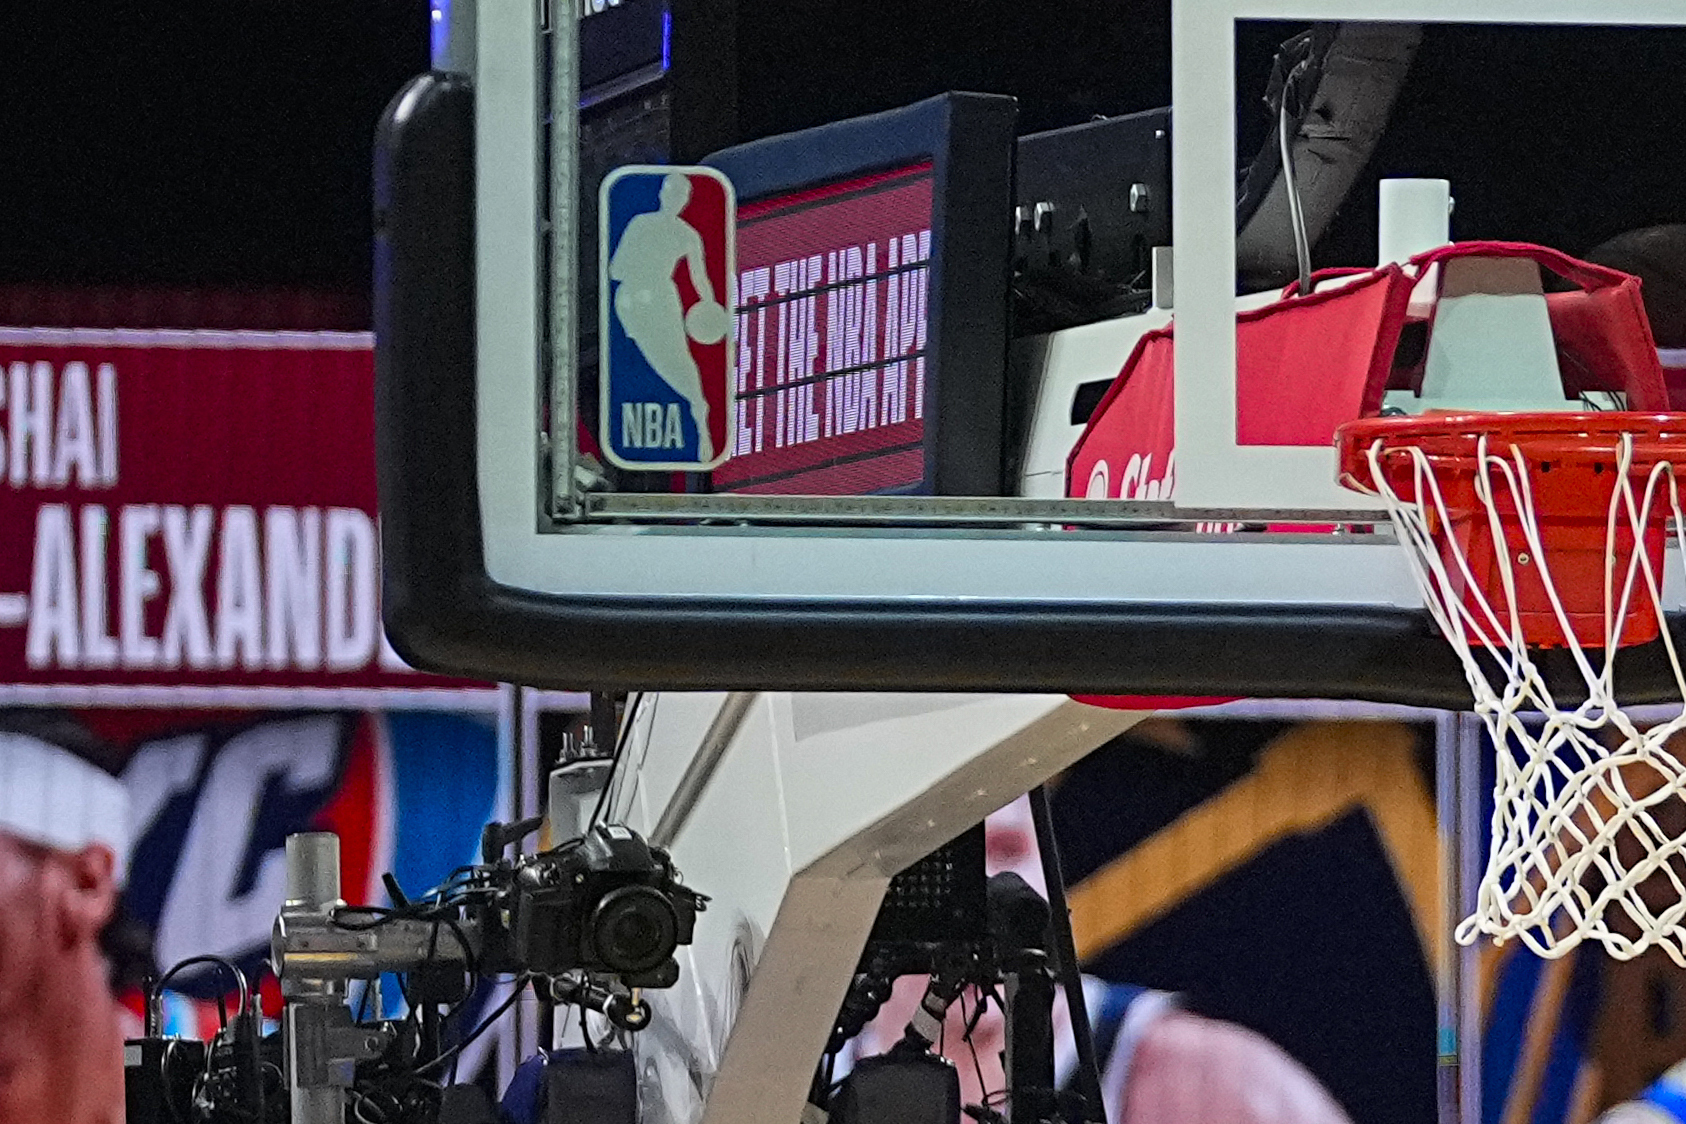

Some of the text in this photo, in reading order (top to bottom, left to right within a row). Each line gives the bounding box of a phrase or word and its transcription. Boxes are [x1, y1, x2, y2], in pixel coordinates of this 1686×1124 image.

[775, 255, 823, 449] THE
[824, 241, 878, 438] NBA
[0, 360, 120, 491] HAI
[620, 401, 686, 450] NBA
[0, 504, 415, 675] -ALEXAND
